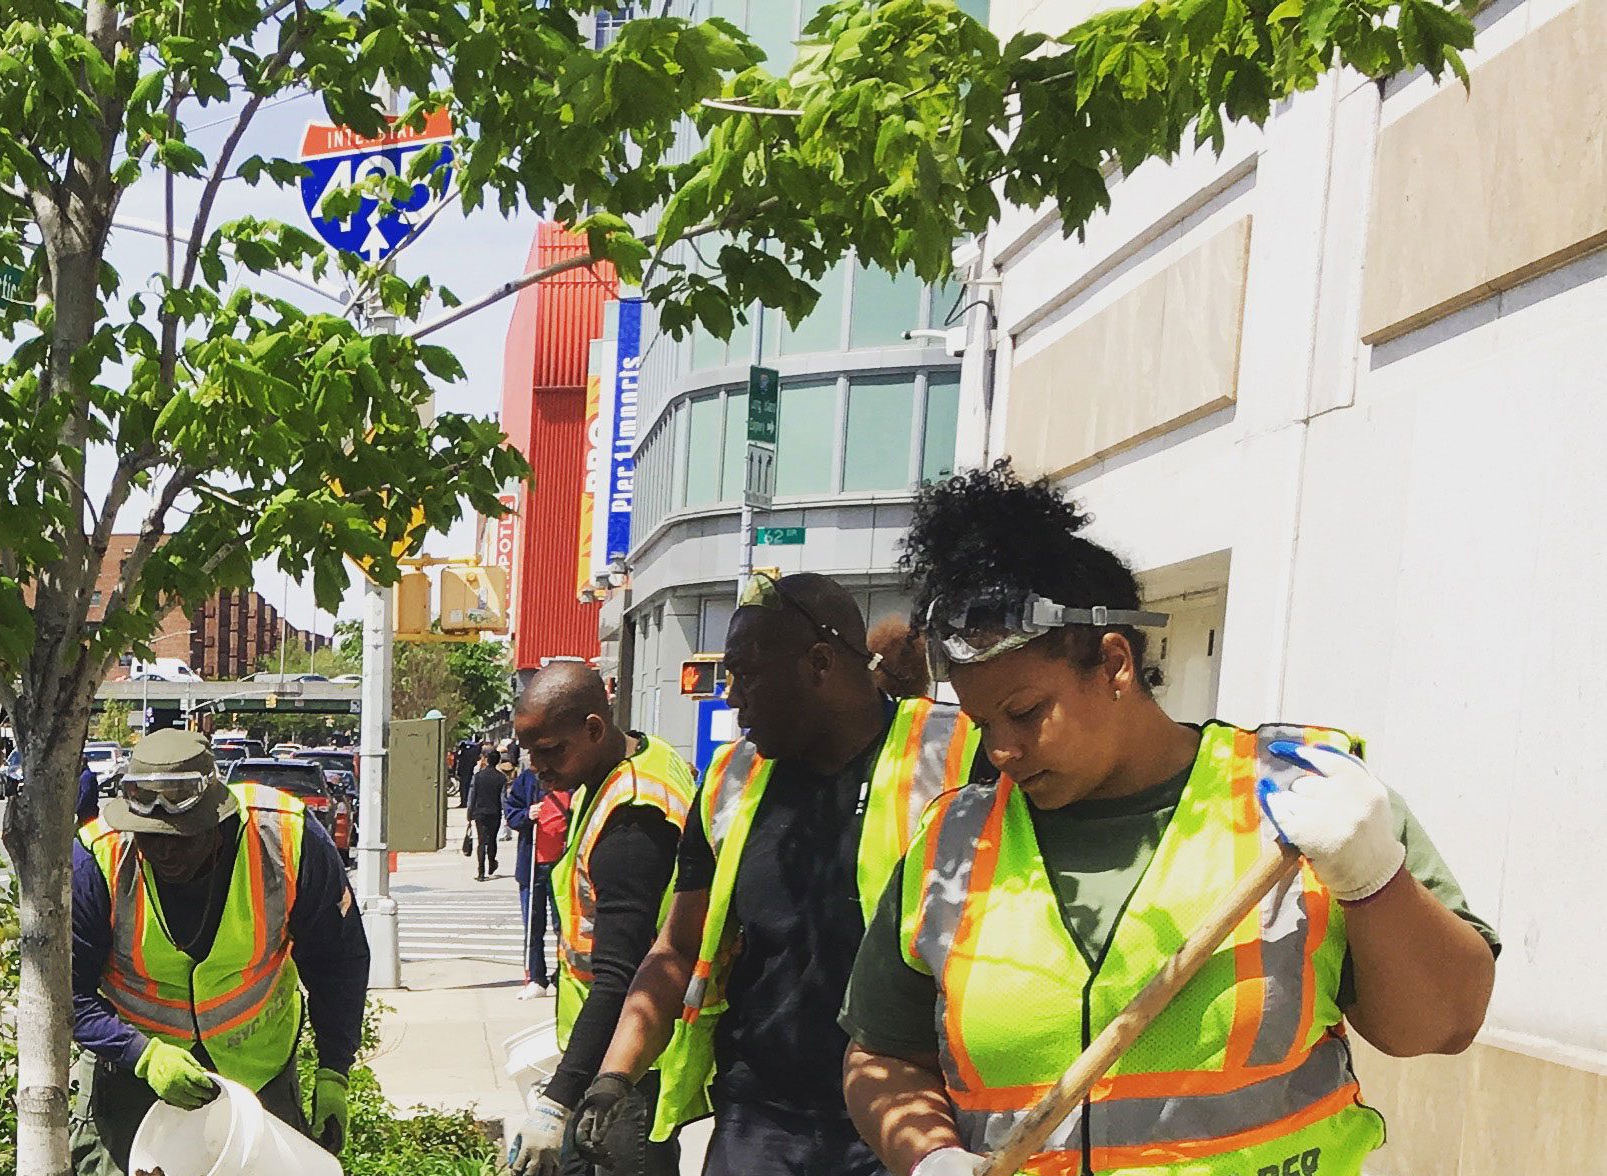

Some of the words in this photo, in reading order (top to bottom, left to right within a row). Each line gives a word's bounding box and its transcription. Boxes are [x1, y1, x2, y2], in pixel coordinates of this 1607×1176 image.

[311, 151, 441, 232] 495
[615, 356, 640, 446] Imports
[611, 466, 634, 512] Pier
[764, 529, 784, 545] 62
